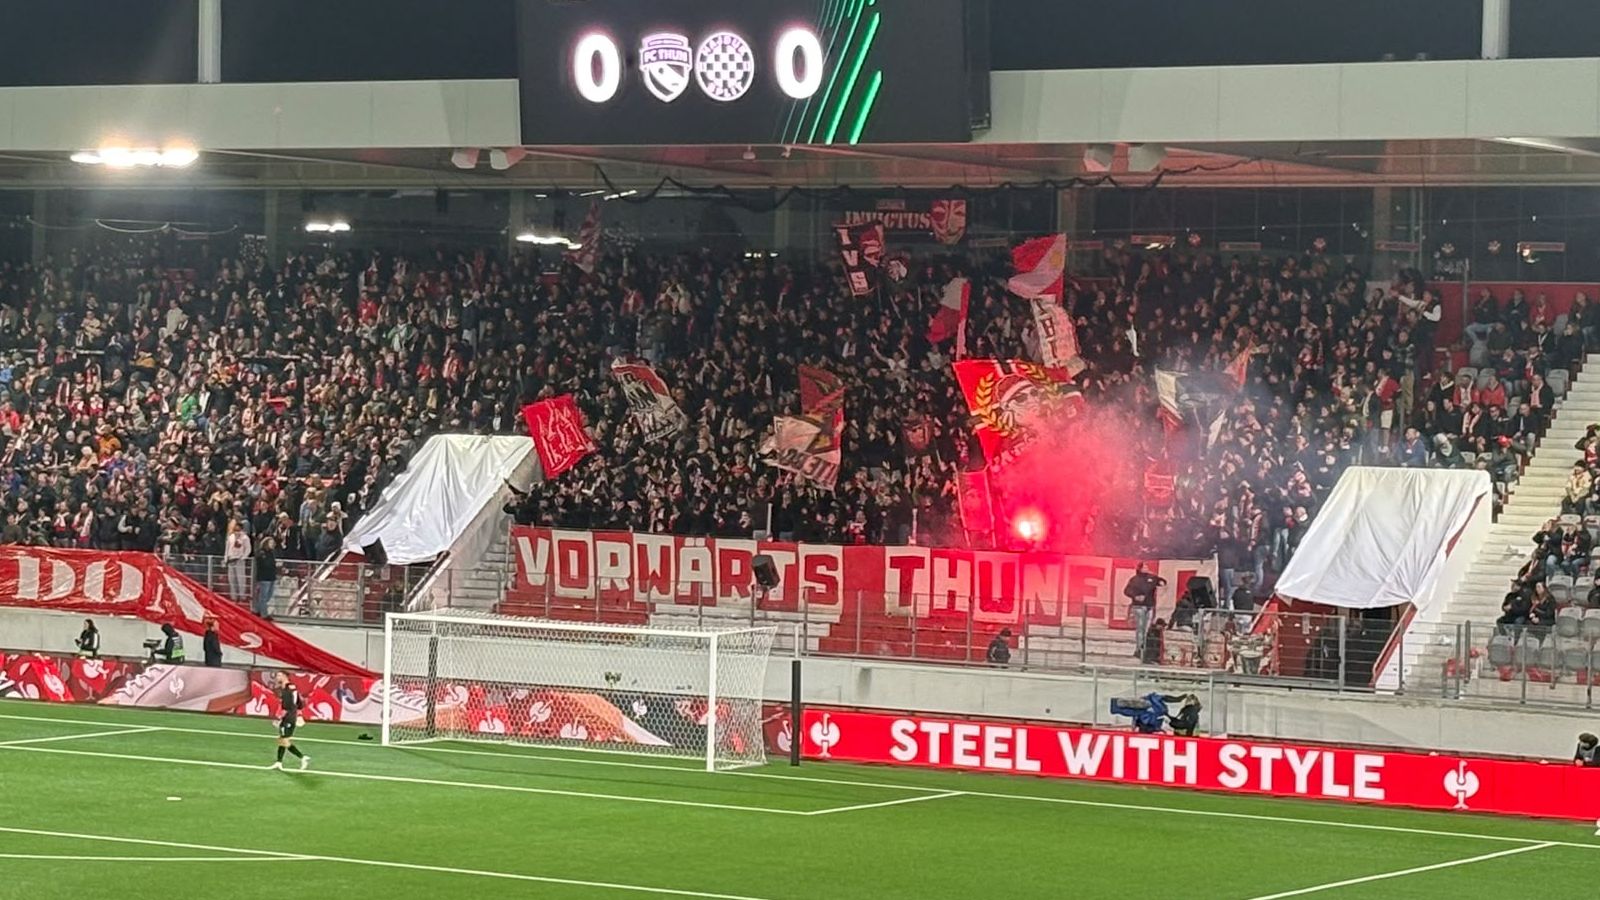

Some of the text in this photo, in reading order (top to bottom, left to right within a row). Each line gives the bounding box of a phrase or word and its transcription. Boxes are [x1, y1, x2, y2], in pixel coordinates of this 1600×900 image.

[574, 34, 620, 102] 0
[644, 48, 688, 63] FC THUN
[707, 81, 743, 98] SPLIT
[775, 28, 823, 99] 0
[845, 211, 931, 229] INVICTUS
[517, 535, 1200, 620] VORWÄRTS THUNE
[889, 719, 1386, 801] STEEL WITH STYLE
